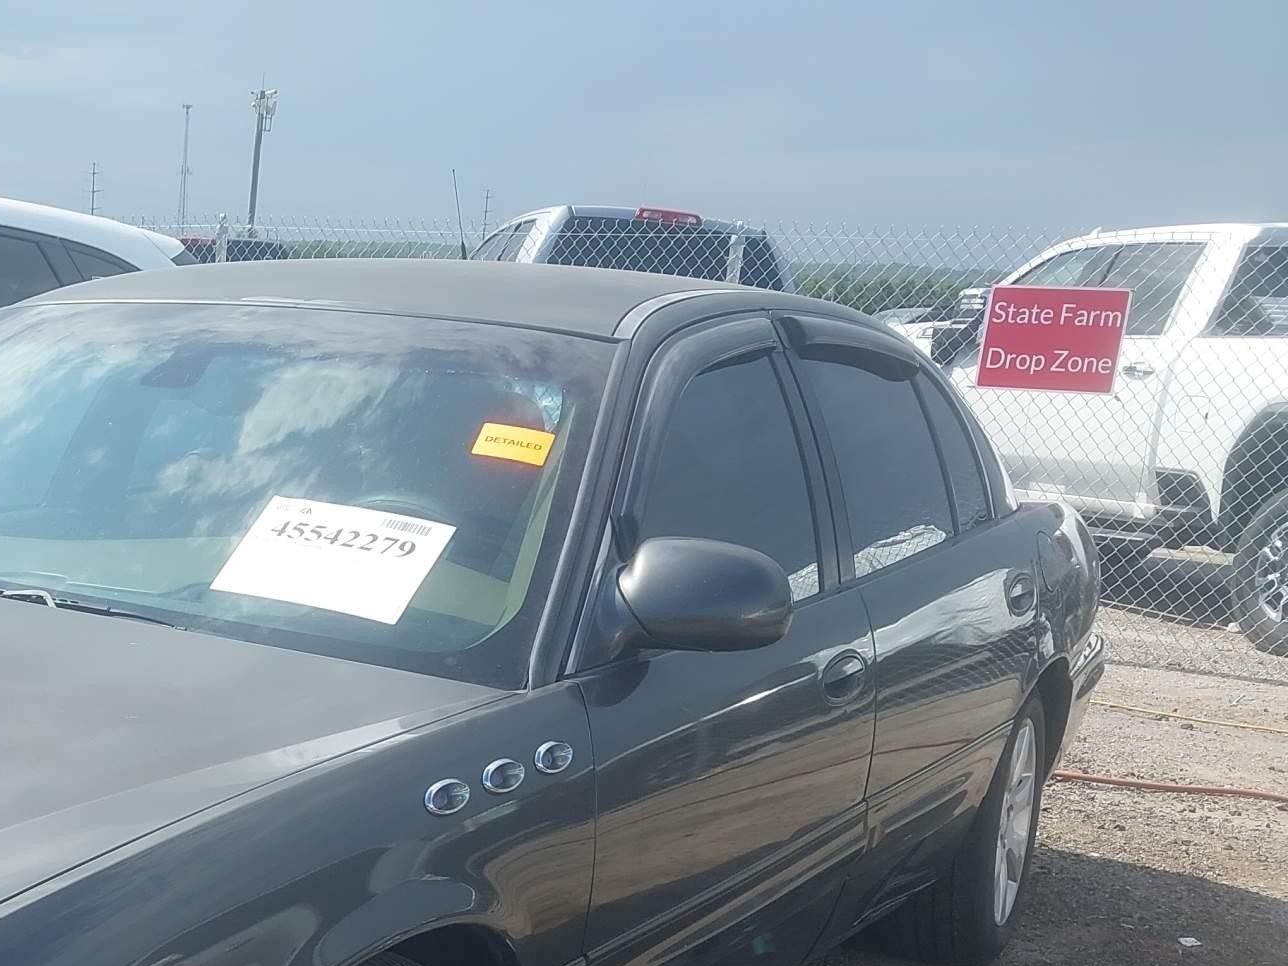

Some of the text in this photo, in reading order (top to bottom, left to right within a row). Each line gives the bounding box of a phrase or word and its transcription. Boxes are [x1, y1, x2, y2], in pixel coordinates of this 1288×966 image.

[992, 301, 1122, 327] State Farm
[986, 347, 1112, 375] Drop Zone
[484, 435, 543, 451] DETAILED
[271, 520, 417, 558] 45542279
